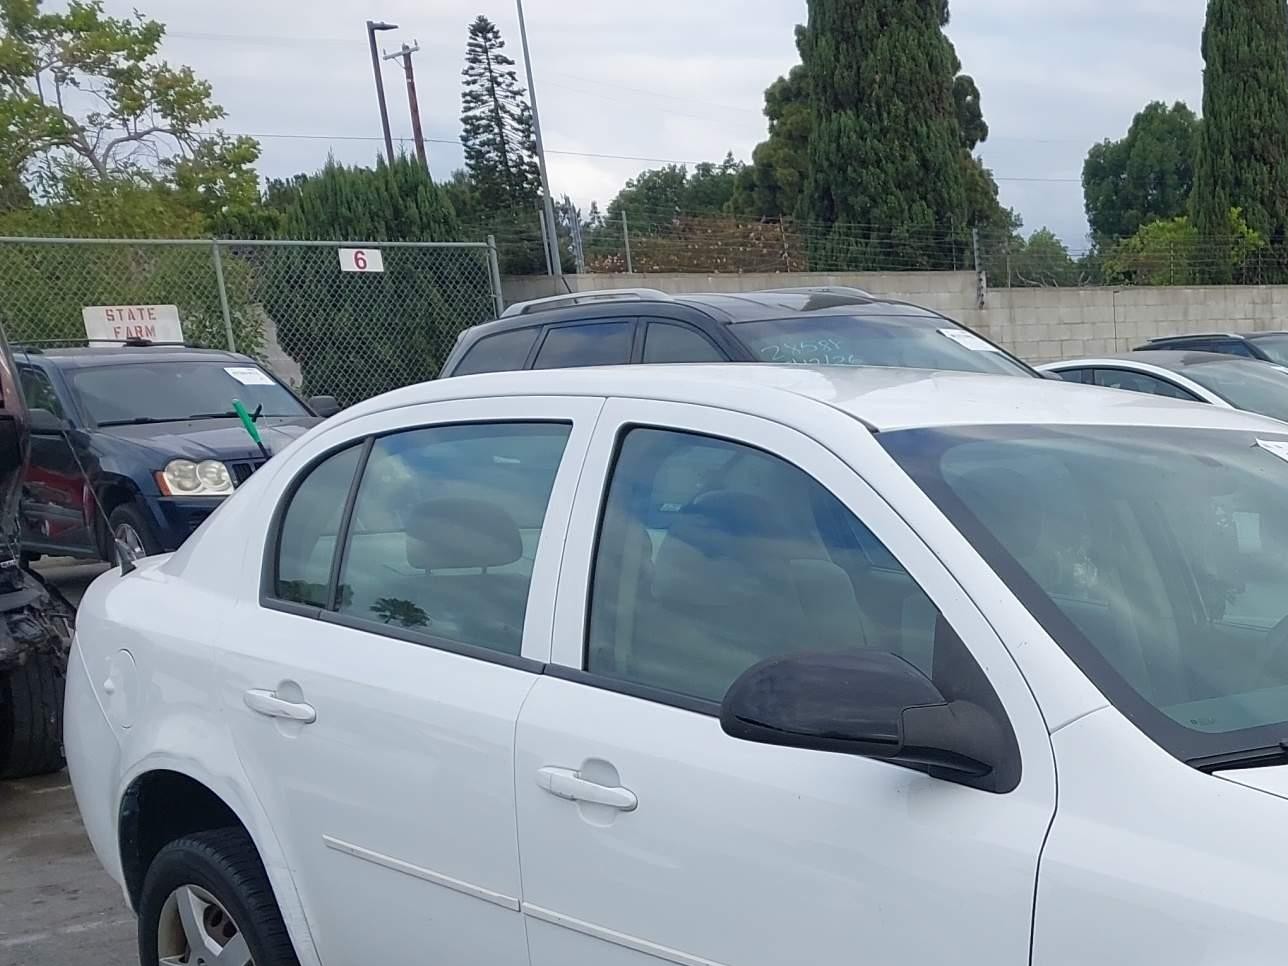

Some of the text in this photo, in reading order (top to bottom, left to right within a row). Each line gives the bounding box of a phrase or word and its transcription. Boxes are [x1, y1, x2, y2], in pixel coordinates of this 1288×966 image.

[354, 250, 367, 270] 6
[106, 307, 157, 322] STATE
[114, 325, 157, 339] FARM
